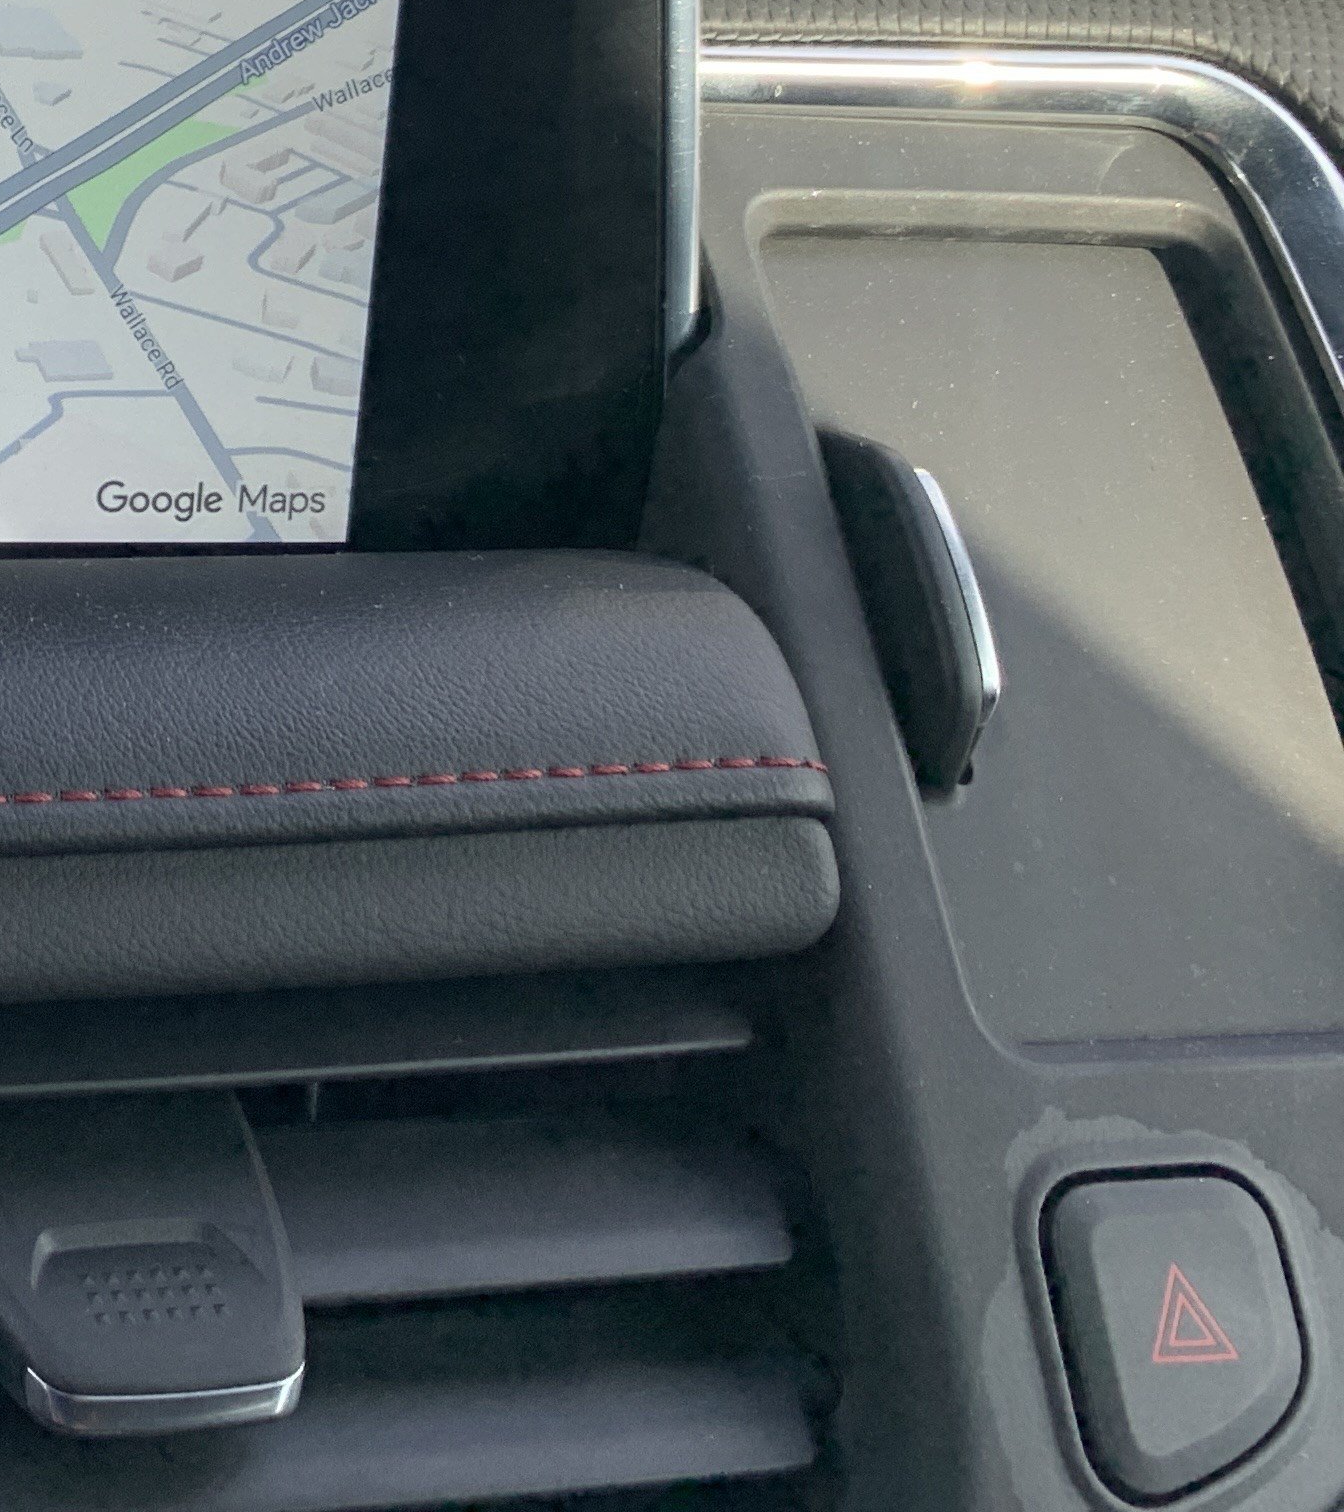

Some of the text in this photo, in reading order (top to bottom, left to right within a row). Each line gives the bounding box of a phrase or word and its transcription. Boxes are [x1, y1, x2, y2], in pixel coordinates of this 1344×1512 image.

[238, 18, 325, 85] Andrew
[10, 125, 35, 154] Ln
[110, 282, 185, 392] Wallace Rd
[96, 480, 327, 522] Google Maps
